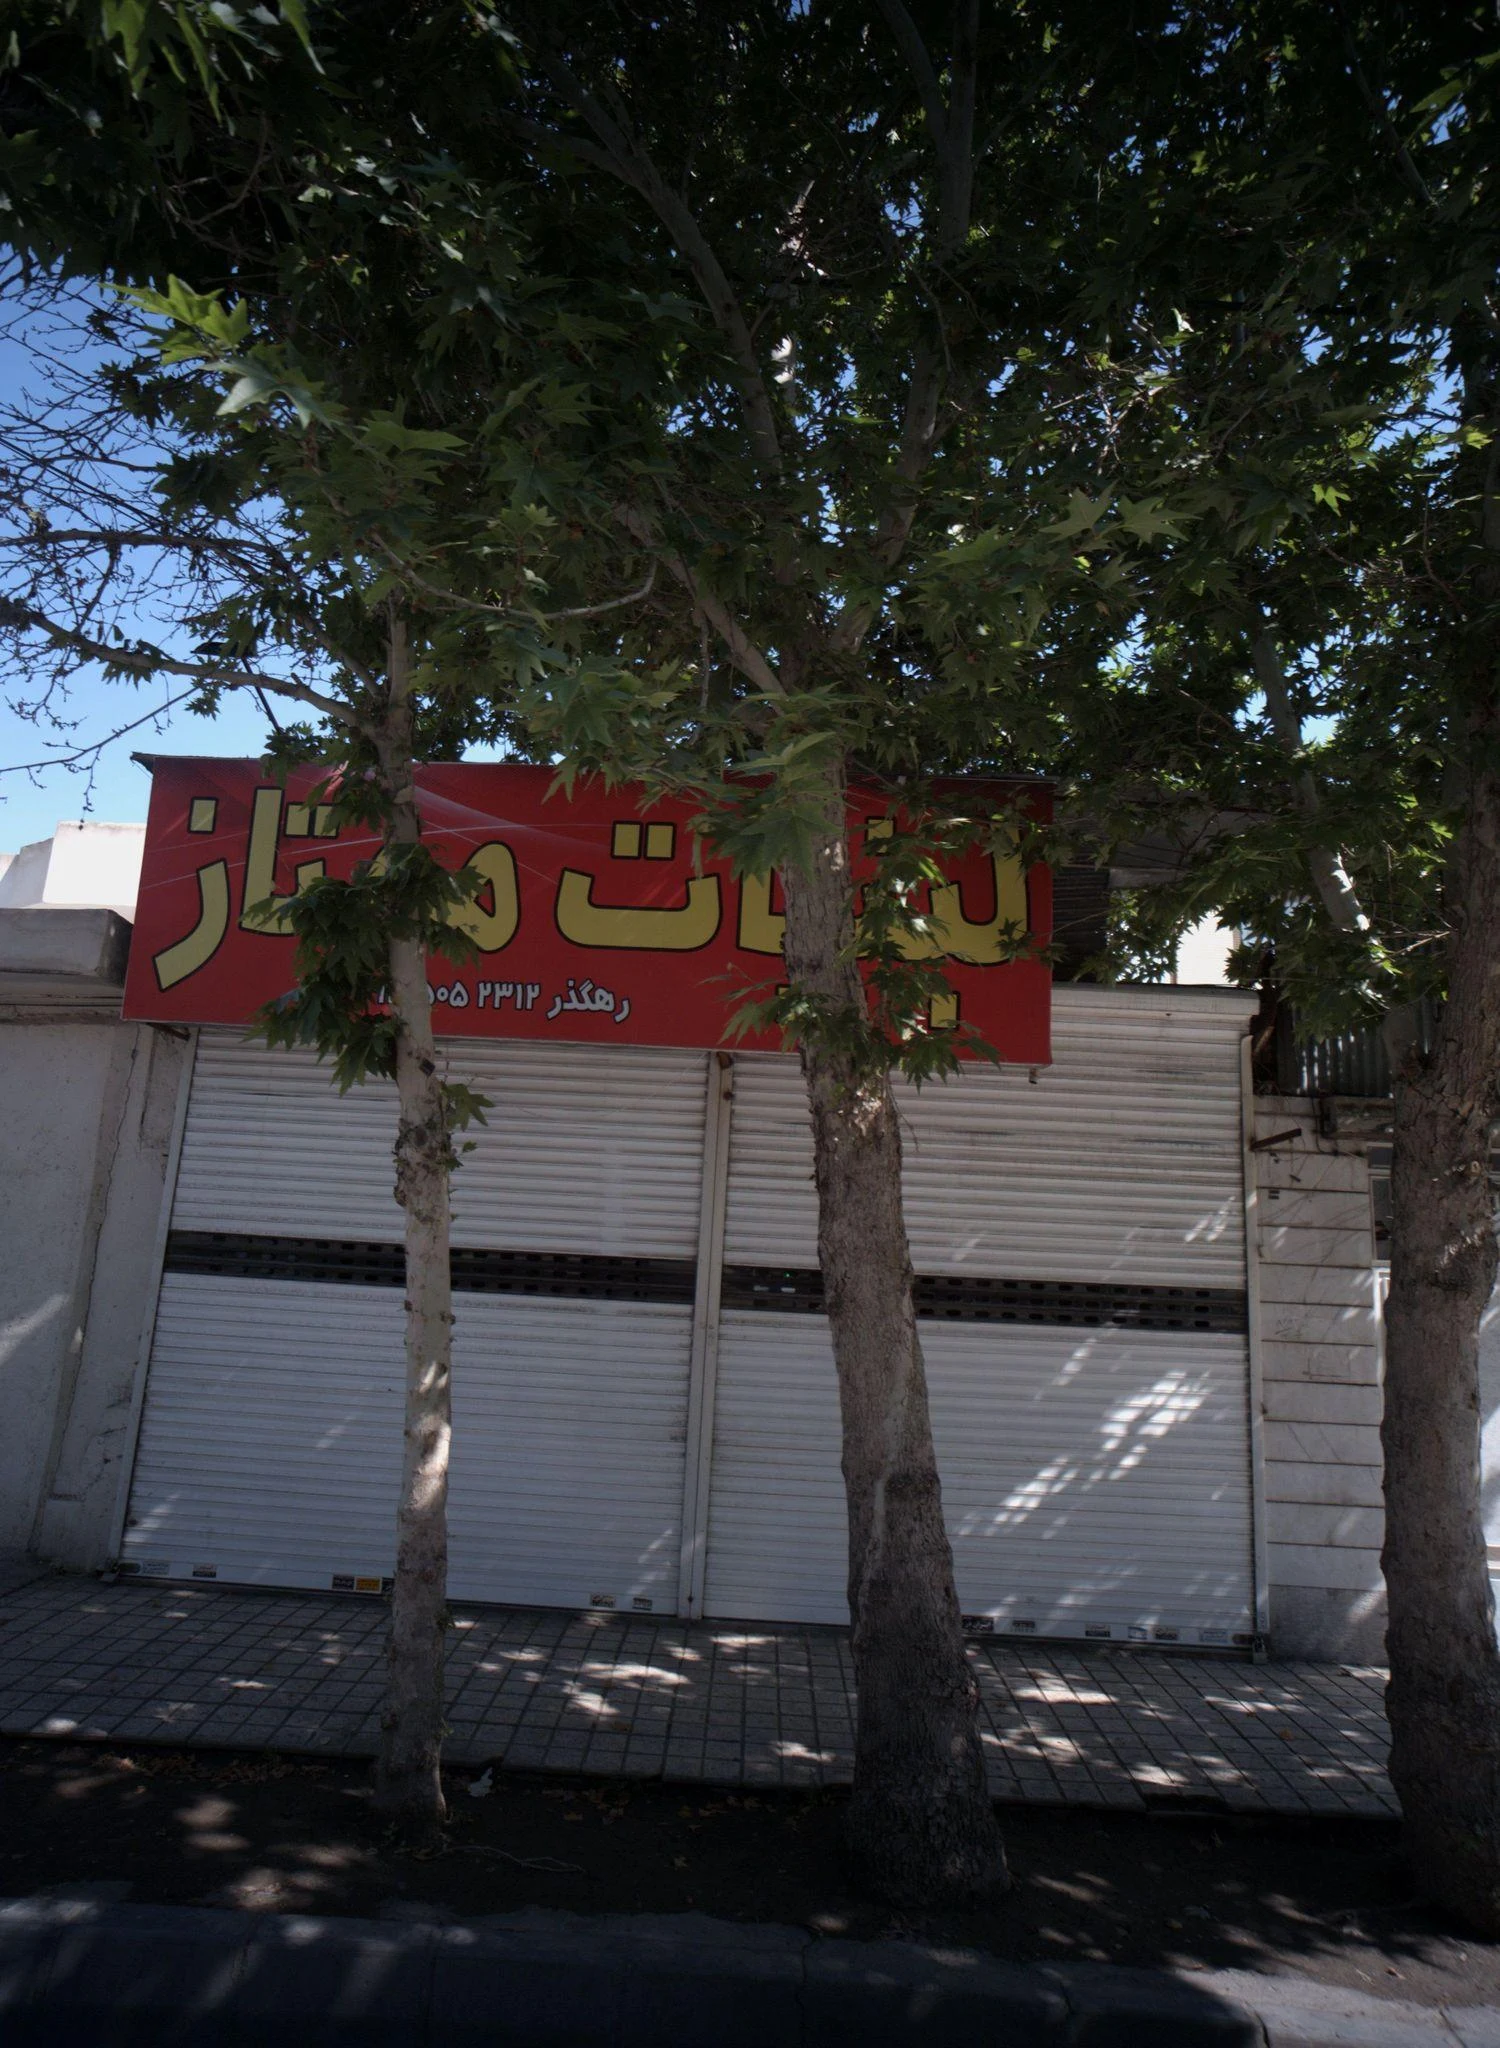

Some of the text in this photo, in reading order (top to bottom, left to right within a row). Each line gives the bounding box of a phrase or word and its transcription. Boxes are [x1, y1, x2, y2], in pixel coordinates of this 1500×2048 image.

[152, 785, 1030, 1029] لبنات متاز
[477, 980, 541, 1011] ۲۳۱۲
[546, 977, 632, 1024] رهگذر
